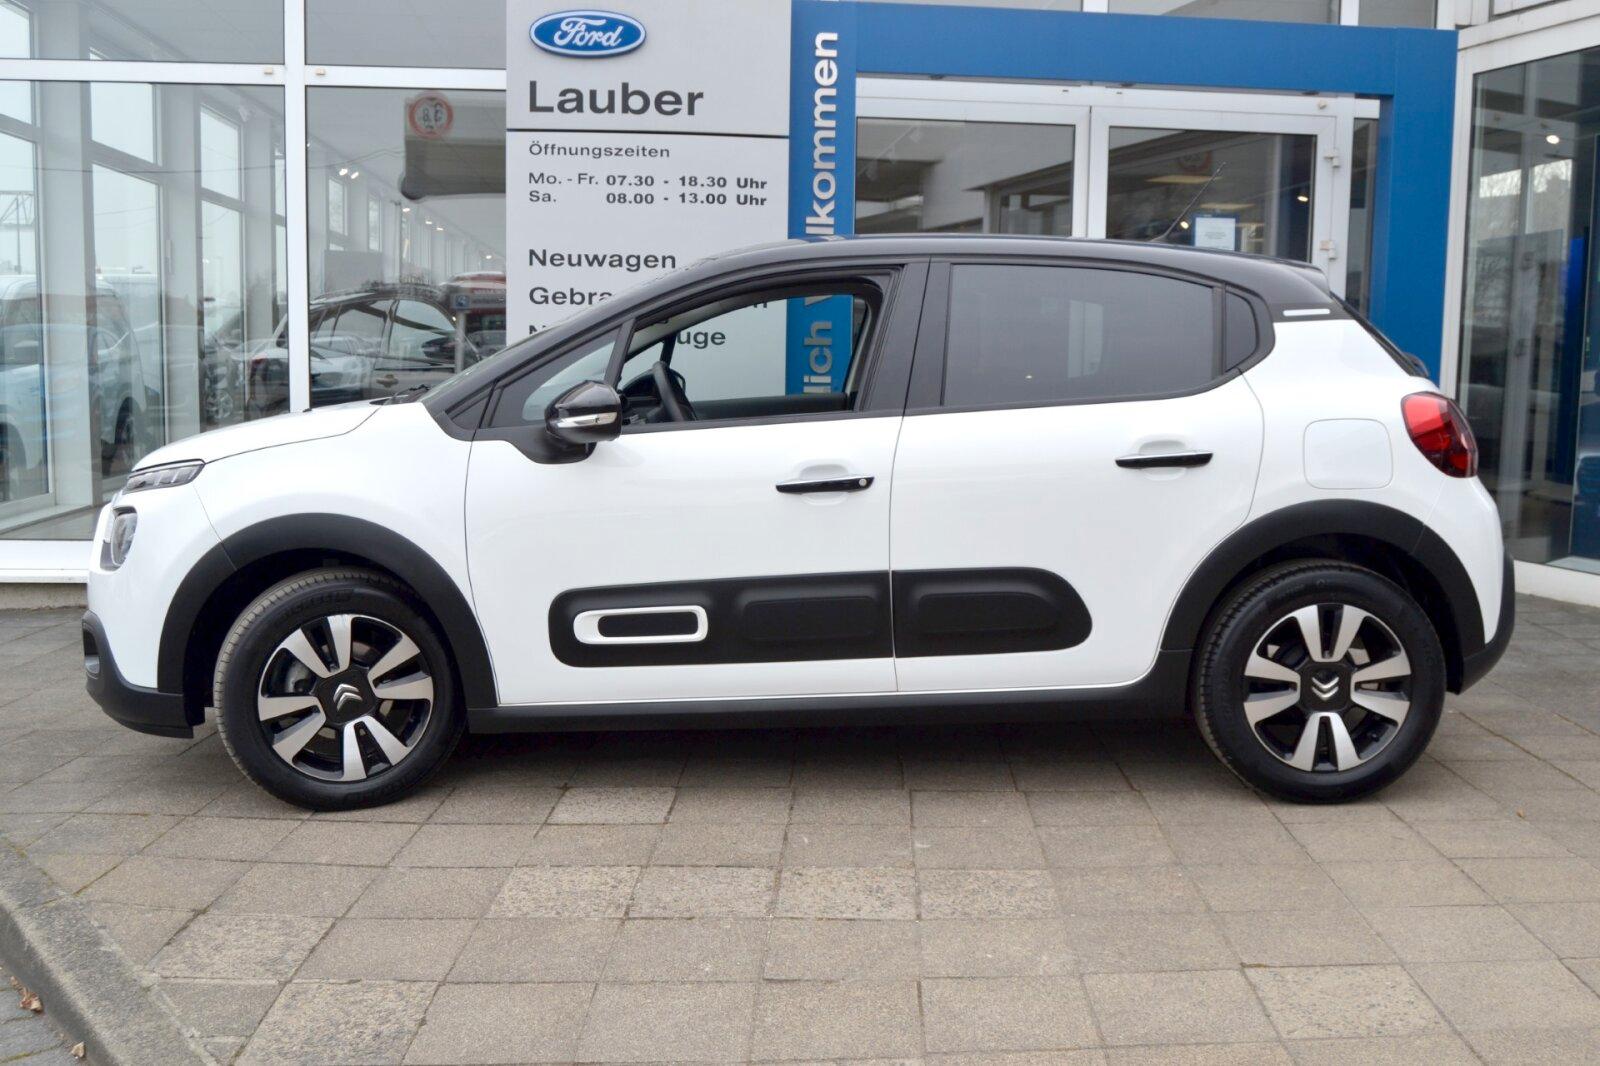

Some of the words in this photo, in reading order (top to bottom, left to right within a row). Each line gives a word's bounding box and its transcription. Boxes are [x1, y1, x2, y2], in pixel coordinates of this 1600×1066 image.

[554, 17, 624, 47] Ford
[529, 80, 704, 116] Lauber
[805, 32, 838, 235] lkommen
[528, 141, 670, 159] Öffnungszeiten
[528, 172, 562, 185] Mo.
[578, 173, 599, 185] Fr.
[606, 174, 655, 187] 07.30
[679, 176, 728, 188] 18.30
[736, 177, 768, 189] Uhr
[528, 190, 557, 203] Sa.
[606, 192, 655, 205] 08.00
[678, 192, 728, 205] 13.00
[736, 193, 768, 206] Uhr
[528, 249, 677, 272] Neuwagen
[677, 331, 727, 350] uge
[803, 320, 833, 394] lich
